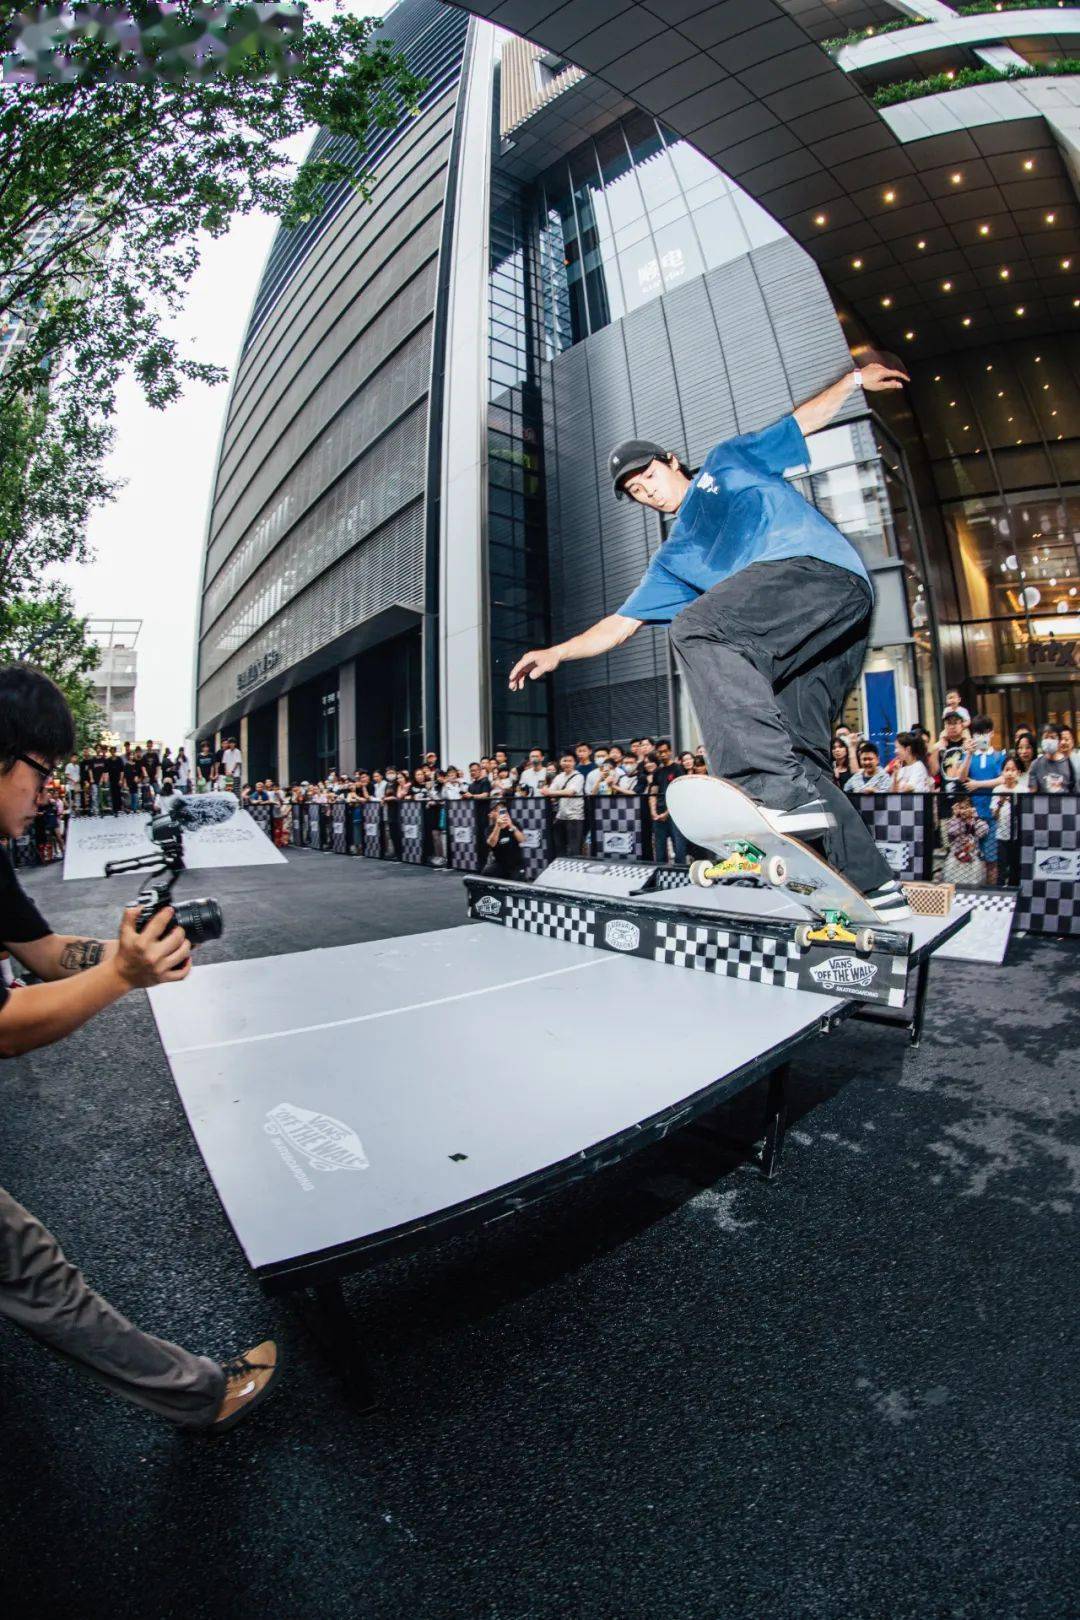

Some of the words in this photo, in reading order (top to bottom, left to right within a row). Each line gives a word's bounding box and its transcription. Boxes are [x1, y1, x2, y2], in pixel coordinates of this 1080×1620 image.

[829, 958, 853, 969] VANS
[833, 969, 850, 982] THE
[289, 1121, 324, 1148] THE
